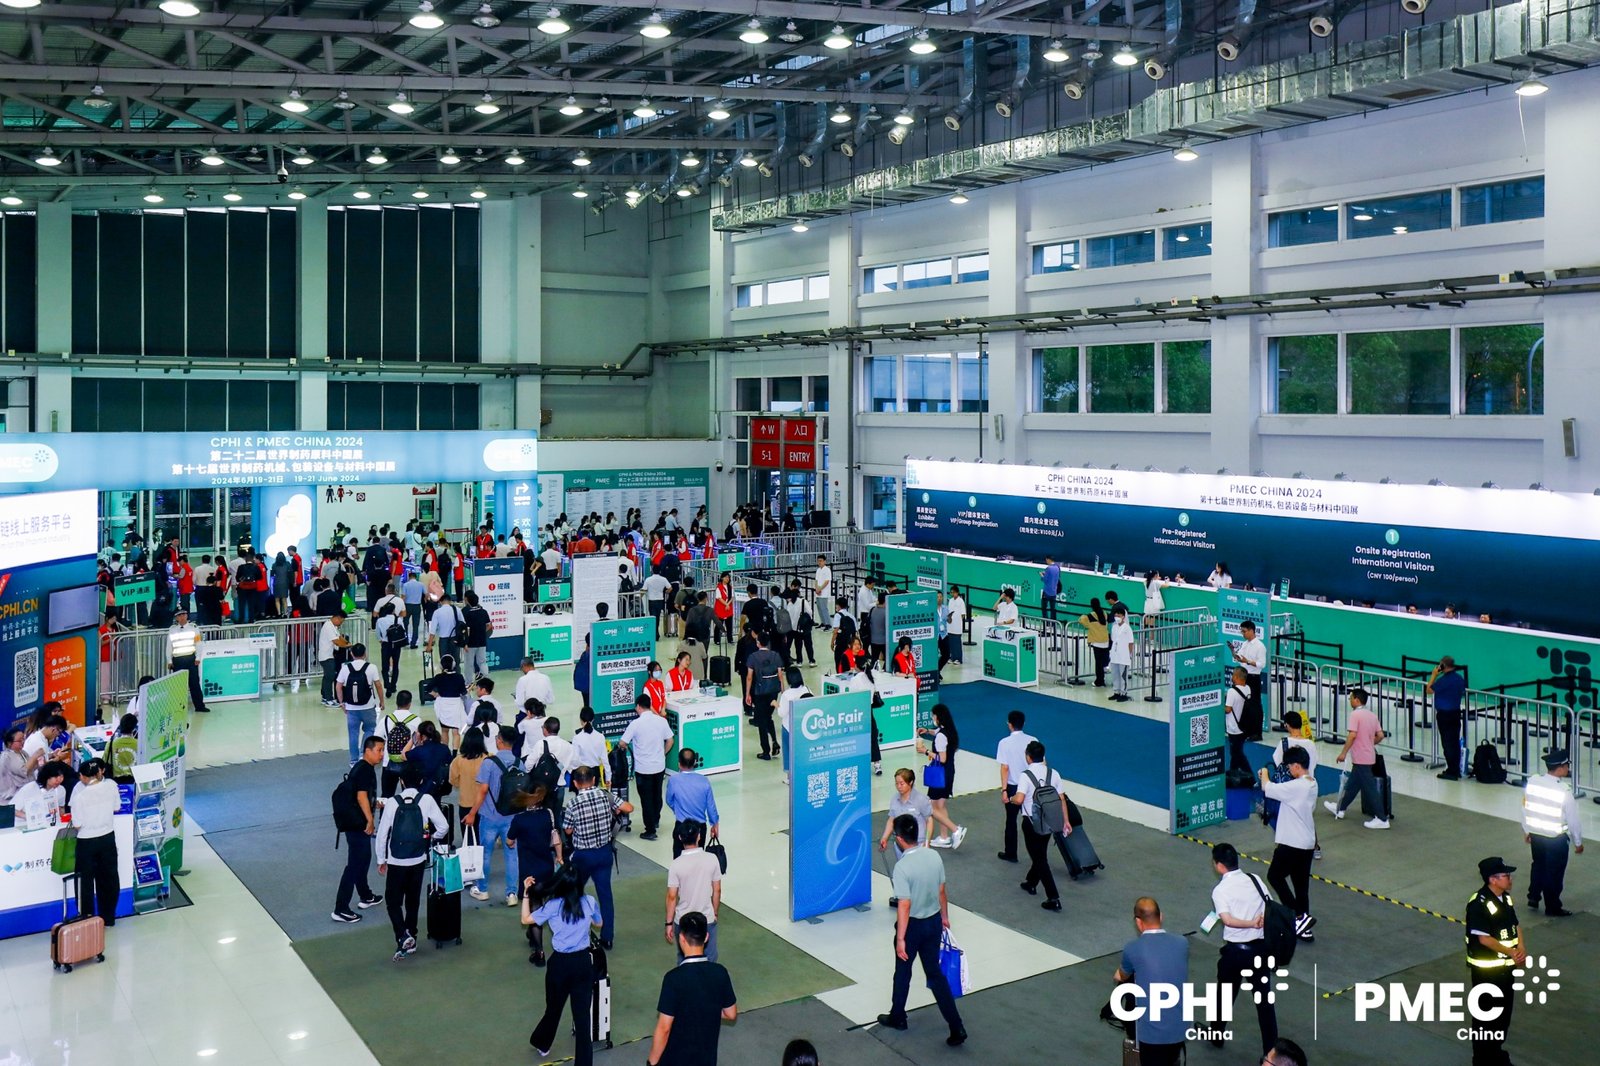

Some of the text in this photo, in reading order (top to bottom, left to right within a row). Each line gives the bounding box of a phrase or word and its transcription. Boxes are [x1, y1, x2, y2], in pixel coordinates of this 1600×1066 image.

[767, 424, 774, 434] W
[794, 424, 808, 436] 入口
[210, 436, 363, 448] CPHI & PMEC CHINA 2024
[210, 449, 363, 462] 第二十二届世界制药原料中国展
[790, 452, 810, 462] ENTRY
[1048, 474, 1113, 485] CPHI CHINA 2024
[1035, 484, 1128, 498] 第二十二届世界制药原料中国展
[1230, 484, 1322, 498] PMEC CHINA 2024
[1200, 495, 1358, 514] 第十七届世界制药机械、包装设备与材料中国展
[972, 519, 998, 528] Registration
[1162, 528, 1206, 538] Pre-Registered
[1154, 537, 1215, 549] International Visitors
[1356, 546, 1430, 559] Onsite Registration
[1352, 556, 1434, 572] International Visitors
[1367, 570, 1418, 584] (CNY 100/person)
[121, 588, 135, 596] VIP
[601, 658, 647, 669] 国内观众登记流程
[810, 709, 863, 730] Job Fair
[712, 725, 735, 734] 展会资料
[1192, 810, 1223, 824] WELCOME
